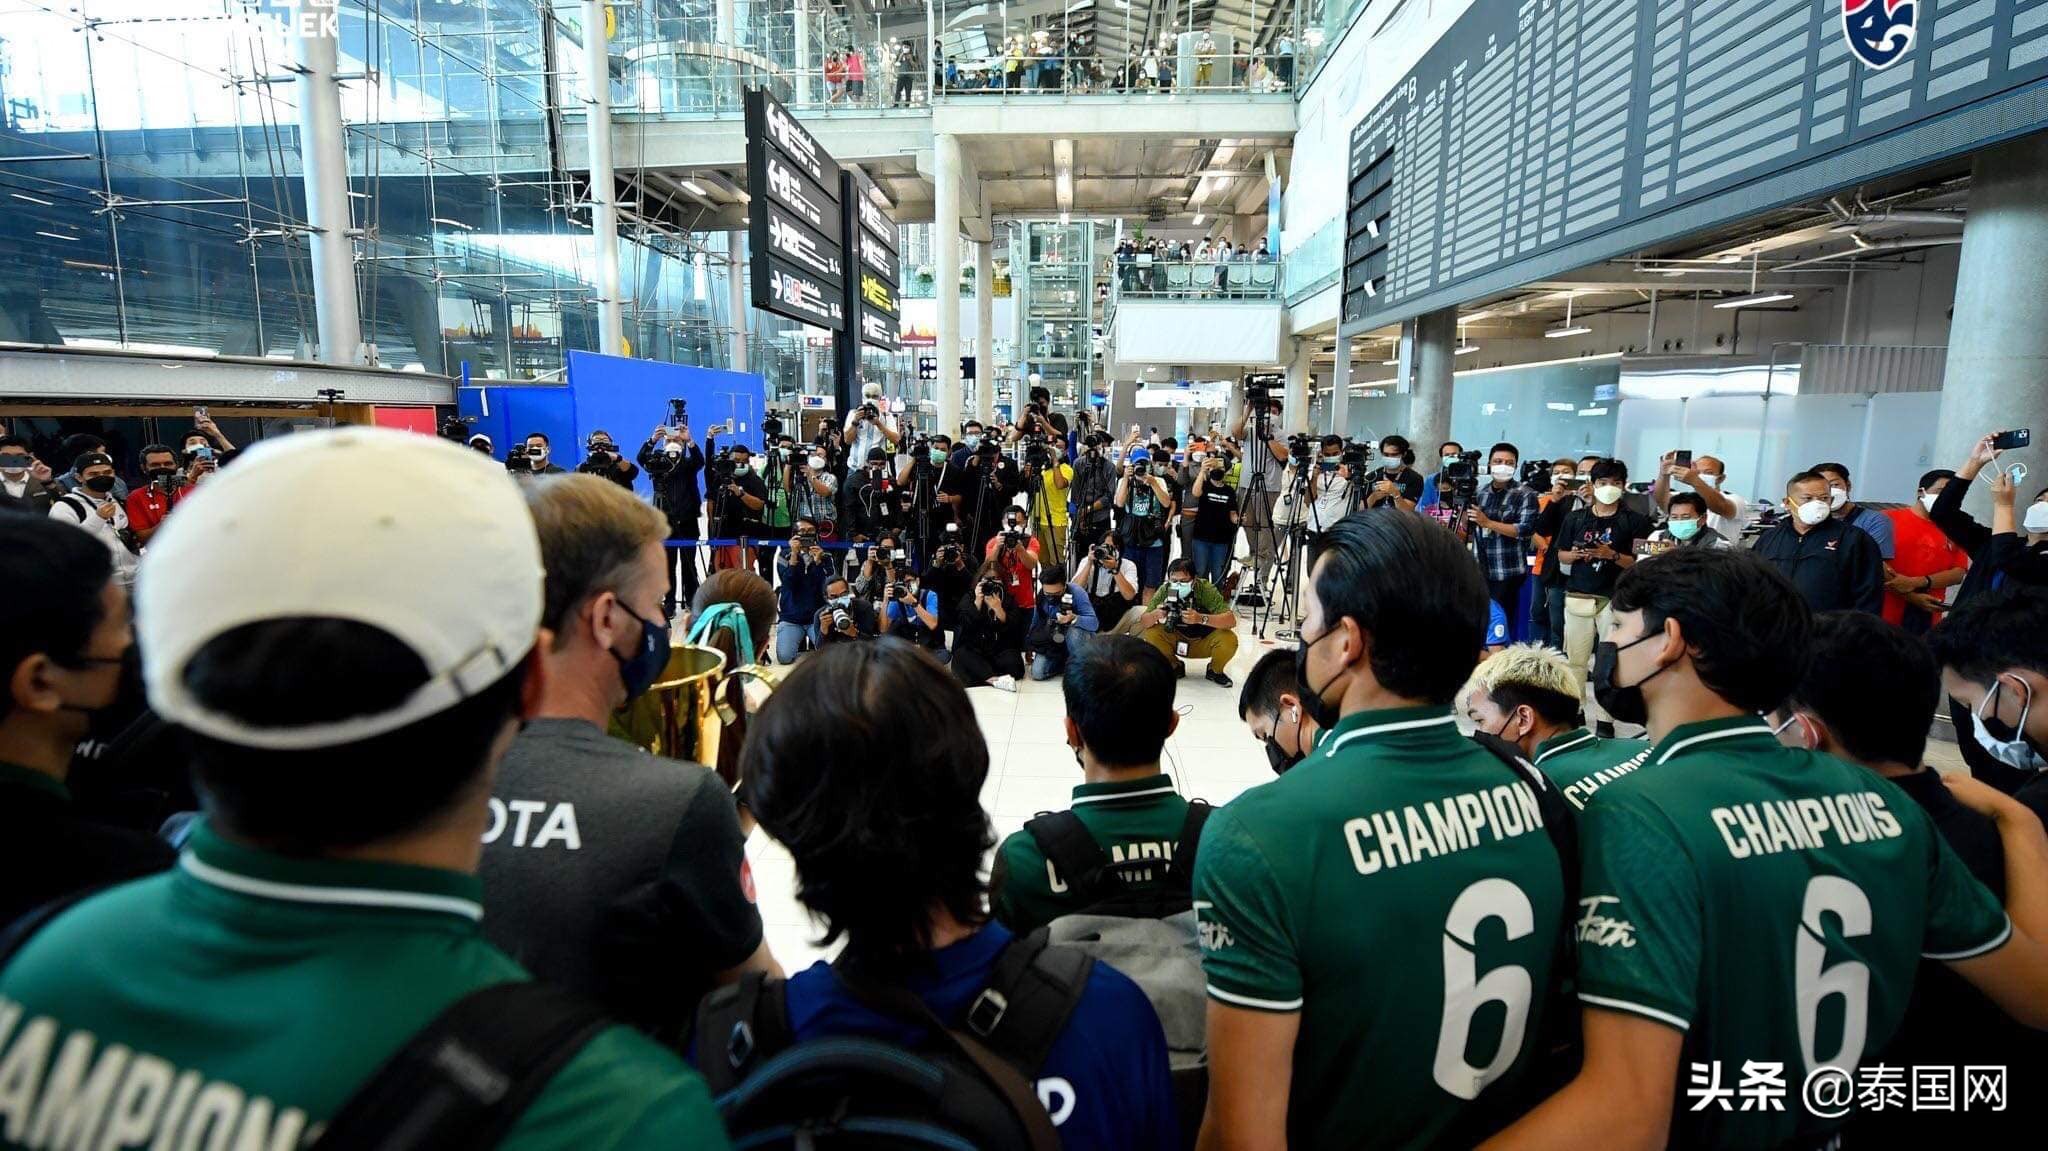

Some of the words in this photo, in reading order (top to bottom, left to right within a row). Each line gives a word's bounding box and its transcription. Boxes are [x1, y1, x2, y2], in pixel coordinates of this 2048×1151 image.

[1408, 76, 1417, 104] B
[480, 797, 582, 851] OTA
[1343, 780, 1544, 876] CHAMPION
[1710, 791, 1903, 860] CHAMPIONS
[1433, 877, 1535, 1101] 6
[1795, 874, 1873, 1098] 6
